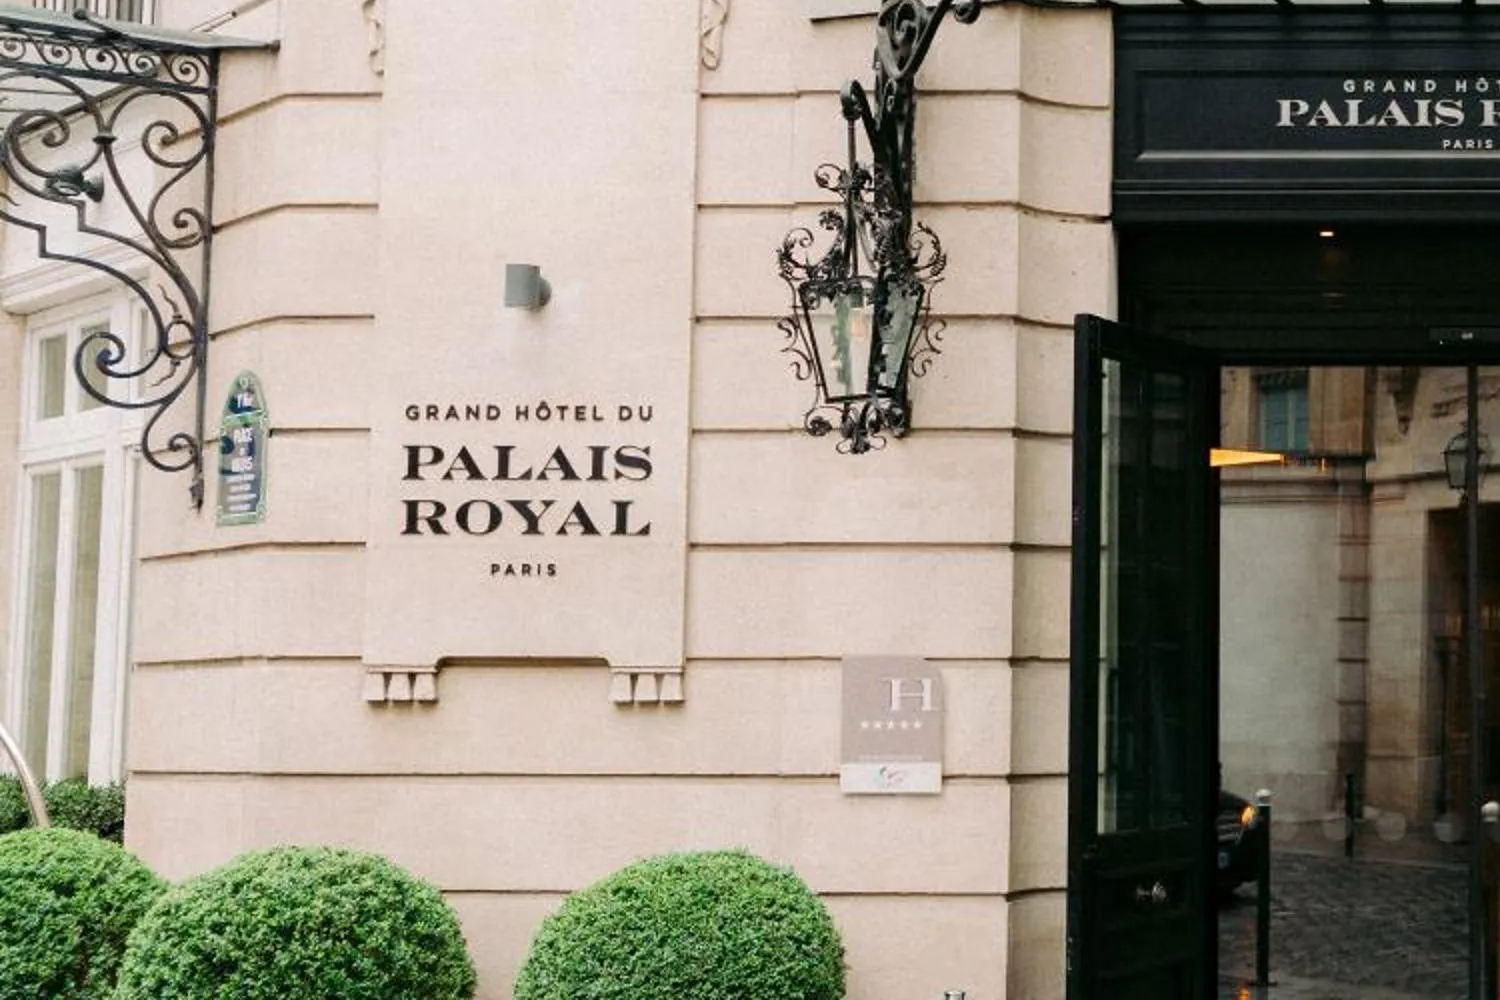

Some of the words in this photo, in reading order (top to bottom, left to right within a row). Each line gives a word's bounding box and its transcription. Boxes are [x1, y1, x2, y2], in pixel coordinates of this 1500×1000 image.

[1343, 79, 1437, 93] GRAND
[1276, 99, 1465, 127] PALAIS
[1442, 138, 1494, 150] PARIS
[405, 404, 501, 422] GRAND
[515, 400, 605, 423] HÔTEL
[618, 405, 653, 423] DU
[401, 444, 653, 482] PALAIS
[400, 499, 652, 537] ROYAL
[490, 563, 557, 577] PARIS
